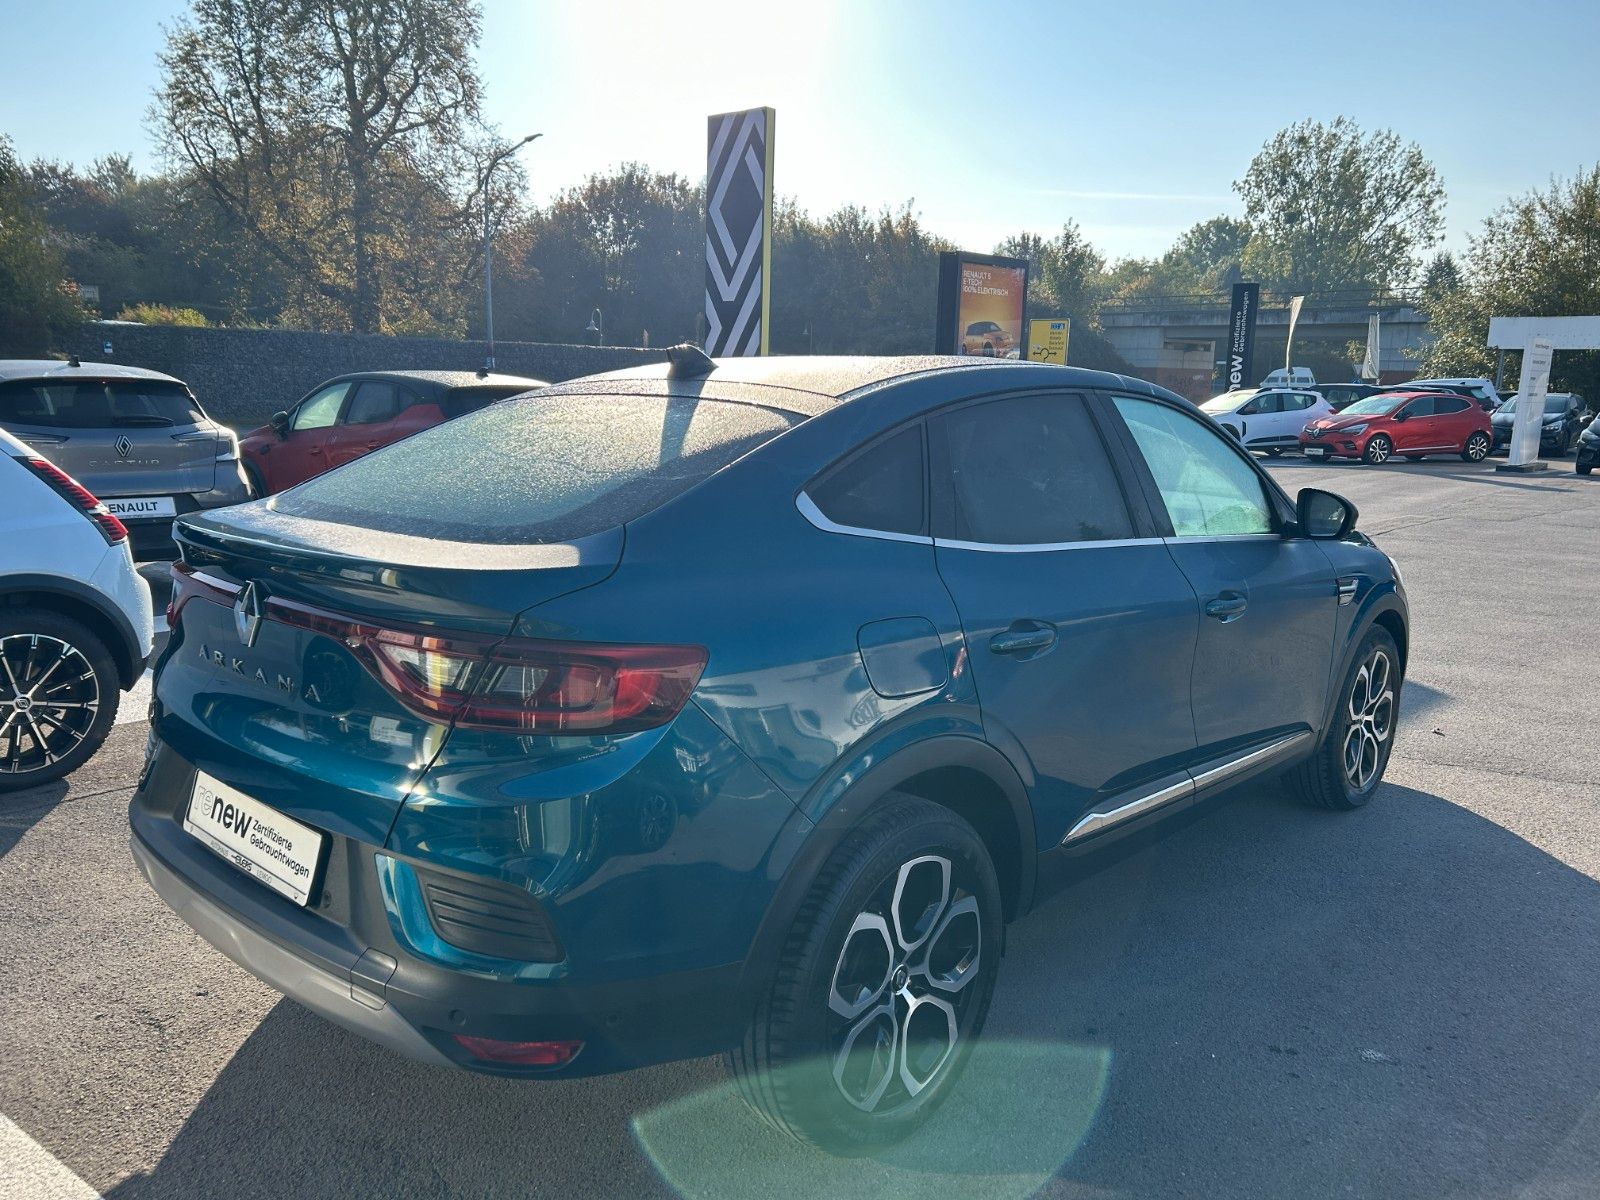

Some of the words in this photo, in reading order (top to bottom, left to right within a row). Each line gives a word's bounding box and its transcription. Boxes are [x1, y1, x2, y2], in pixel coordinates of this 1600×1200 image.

[963, 270, 987, 280] RENAULT
[977, 287, 1009, 296] ELEKTRISCH
[106, 501, 158, 513] ENAULT
[199, 644, 321, 703] ARKANA
[252, 819, 293, 851] Zertifizierte
[250, 833, 310, 879] Gebrauchtwagen
